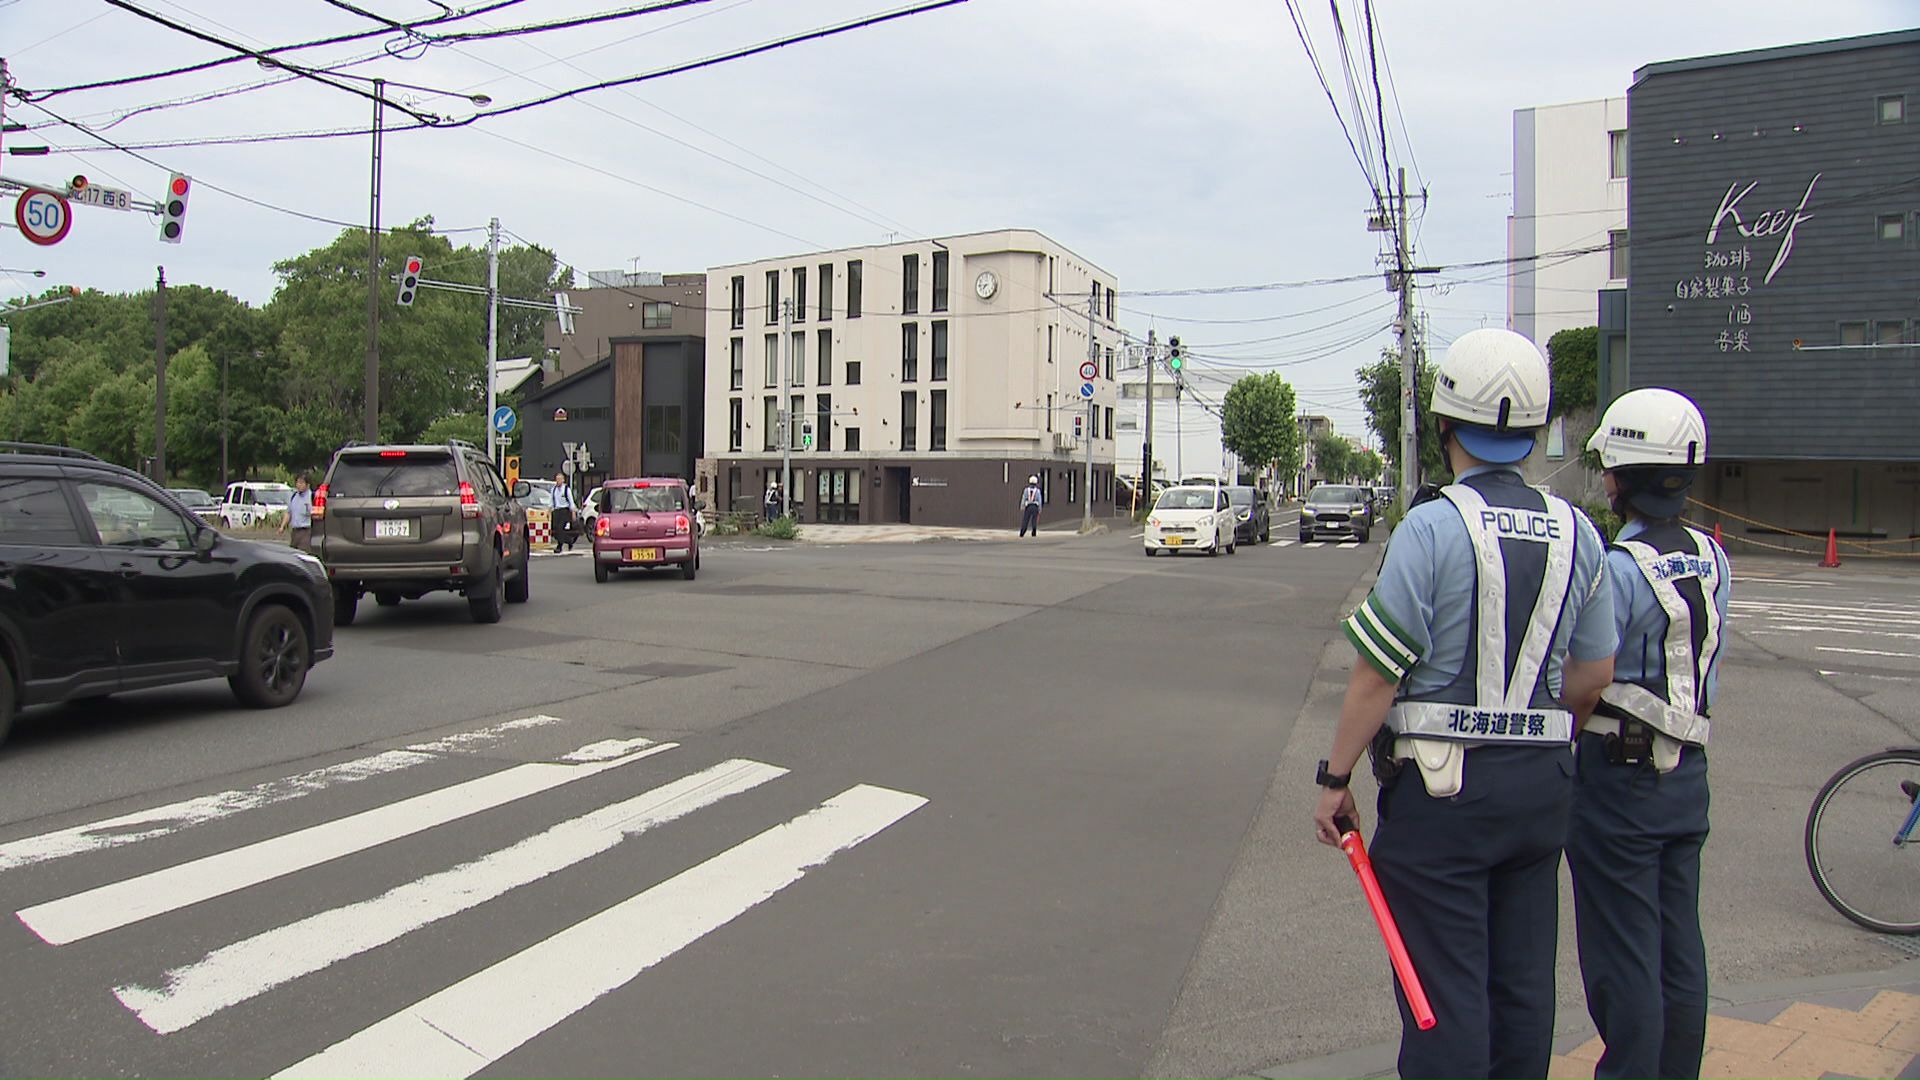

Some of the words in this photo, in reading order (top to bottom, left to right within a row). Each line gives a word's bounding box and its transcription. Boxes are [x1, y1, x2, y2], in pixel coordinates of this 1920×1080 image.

[28, 199, 59, 229] 50
[1706, 172, 1822, 285] Keef
[1704, 246, 1751, 272] 珈琲
[1675, 276, 1751, 300] 自家製菓子
[1728, 303, 1751, 325] 酒
[1715, 329, 1751, 353] 音楽
[1083, 365, 1094, 376] 40
[1480, 511, 1561, 539] POLICE
[1448, 709, 1545, 736] 北海道警察
